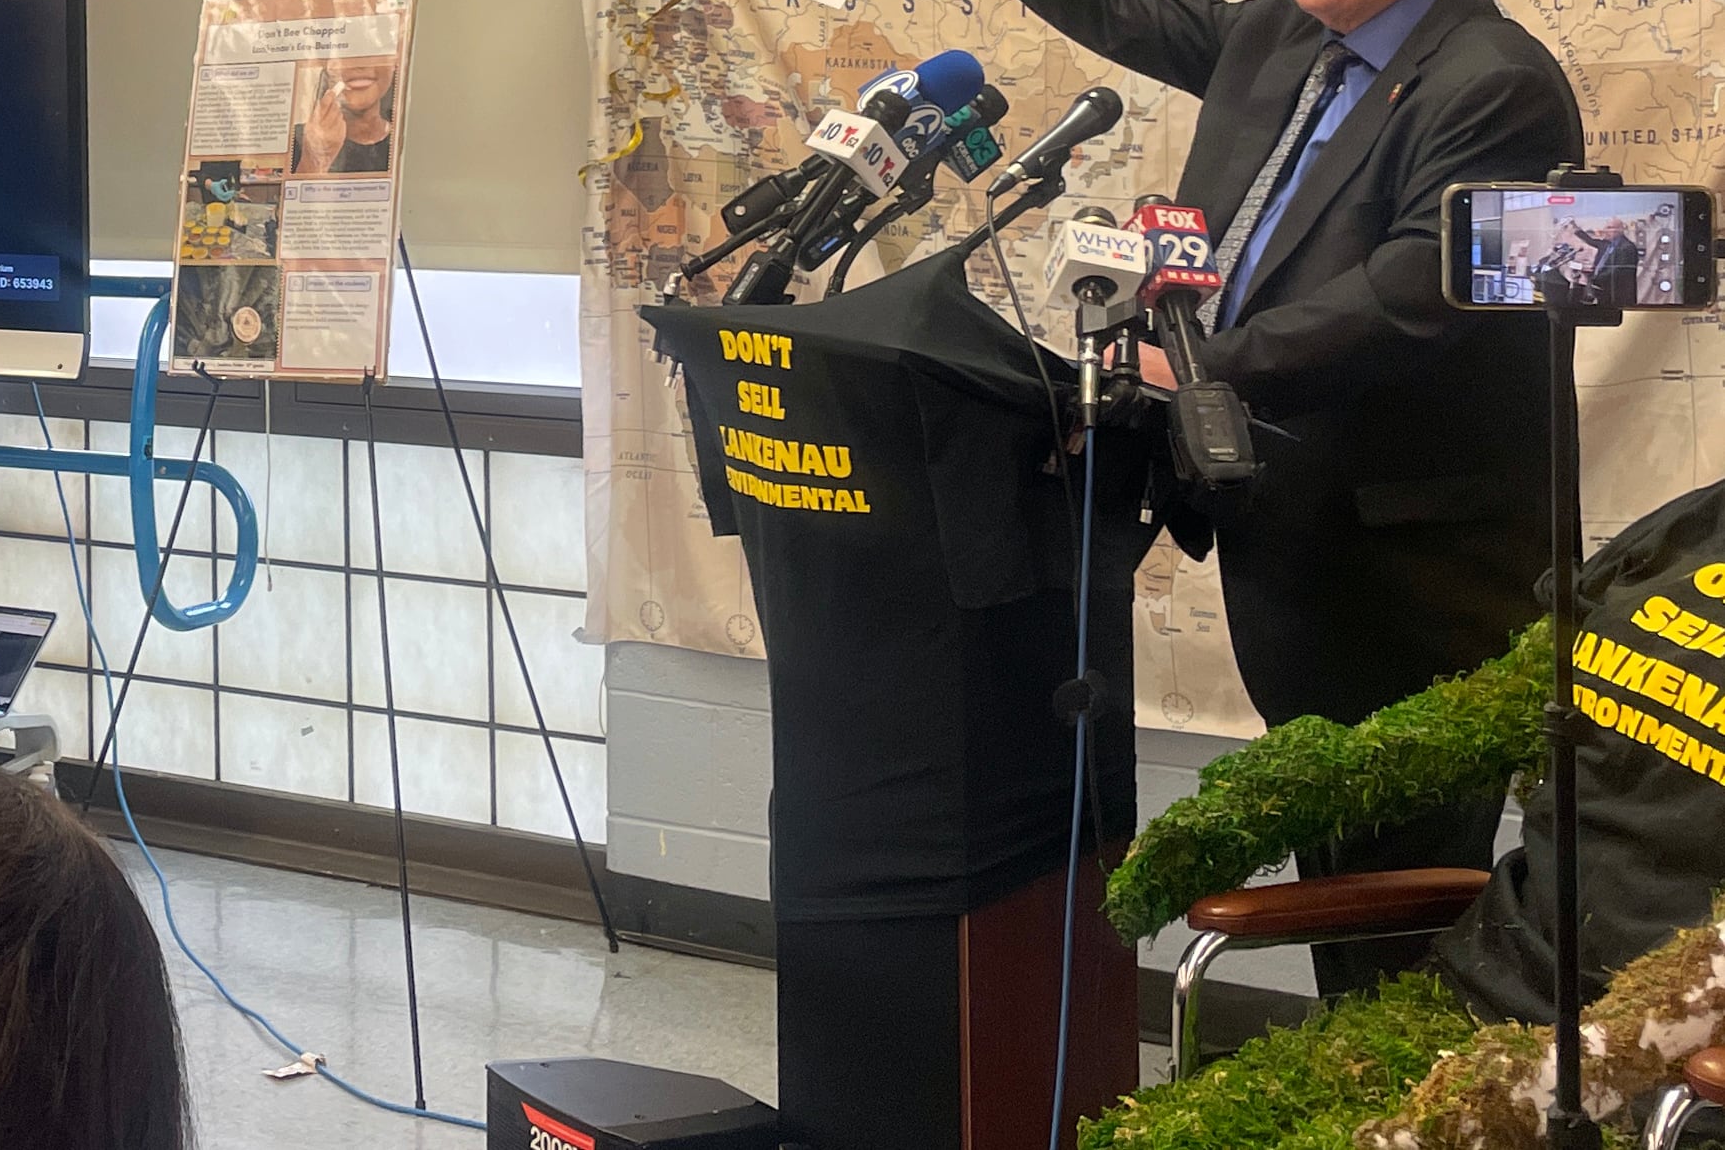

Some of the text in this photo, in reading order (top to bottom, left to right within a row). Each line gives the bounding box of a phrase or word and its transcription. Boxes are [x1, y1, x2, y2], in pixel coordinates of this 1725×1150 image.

[283, 28, 300, 37] Bee
[826, 57, 897, 70] KAZAKHSTAN
[1558, 35, 1601, 118] Mountains
[1585, 124, 1725, 146] UNITED STATE
[881, 223, 909, 237] NDIA
[1155, 209, 1201, 230] FOX
[1072, 229, 1138, 252] WHYY
[1158, 233, 1209, 268] 29
[13, 277, 53, 289] 653943
[1167, 271, 1217, 283] NEWS
[718, 329, 793, 370] DON'T
[737, 380, 786, 420] SELL
[719, 425, 853, 479] LANKENAU
